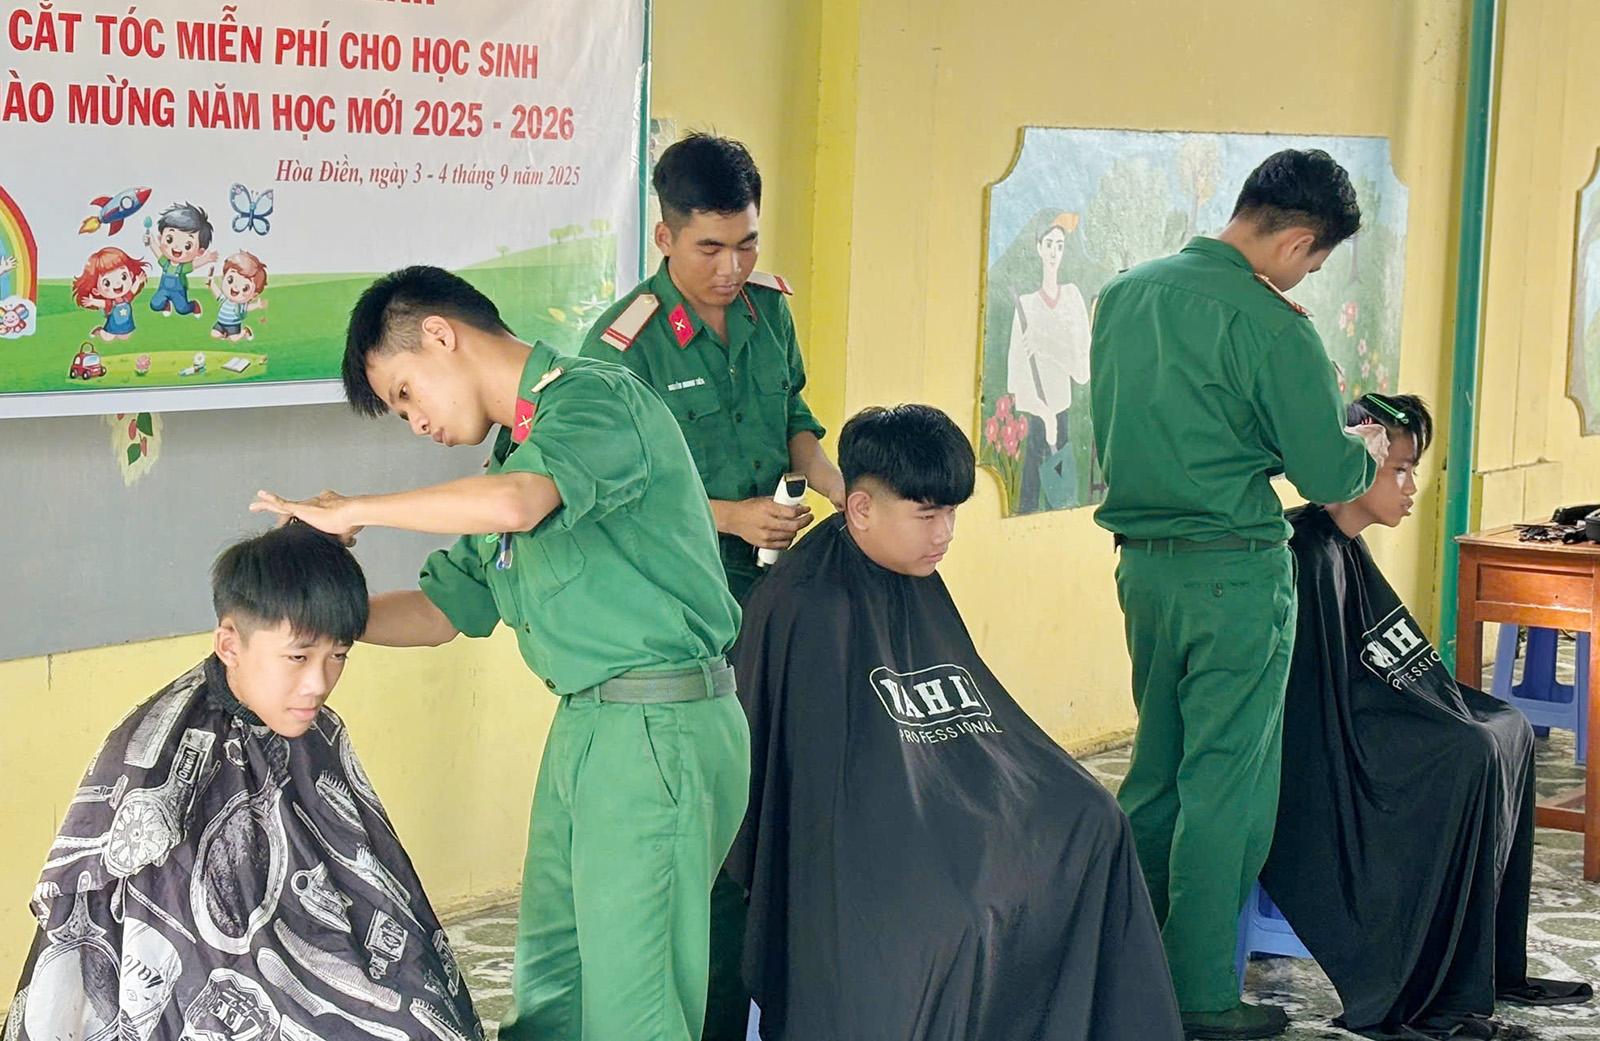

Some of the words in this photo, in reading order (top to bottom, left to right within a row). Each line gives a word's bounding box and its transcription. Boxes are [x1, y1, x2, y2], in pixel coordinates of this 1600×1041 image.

[95, 6, 166, 58] TÓC
[177, 5, 263, 64] MIỄN
[274, 20, 330, 67] PHÍ
[339, 32, 401, 72] CHO
[411, 36, 470, 82] HỌC
[478, 41, 538, 79] SINH
[68, 74, 175, 127] MỪNG
[188, 82, 260, 130] NĂM
[272, 93, 336, 141] HỌC
[347, 88, 403, 135] MỚI
[412, 99, 483, 137] 2025
[492, 121, 502, 129] -
[510, 104, 575, 141] 2026
[275, 159, 314, 182] Hòa
[319, 154, 364, 185] Điền,
[369, 161, 408, 189] ngày
[412, 162, 422, 184] 3
[438, 163, 448, 184] 4
[452, 163, 495, 191] tháng
[500, 164, 509, 186] 9
[513, 166, 543, 185] năm
[547, 165, 581, 186] 2025
